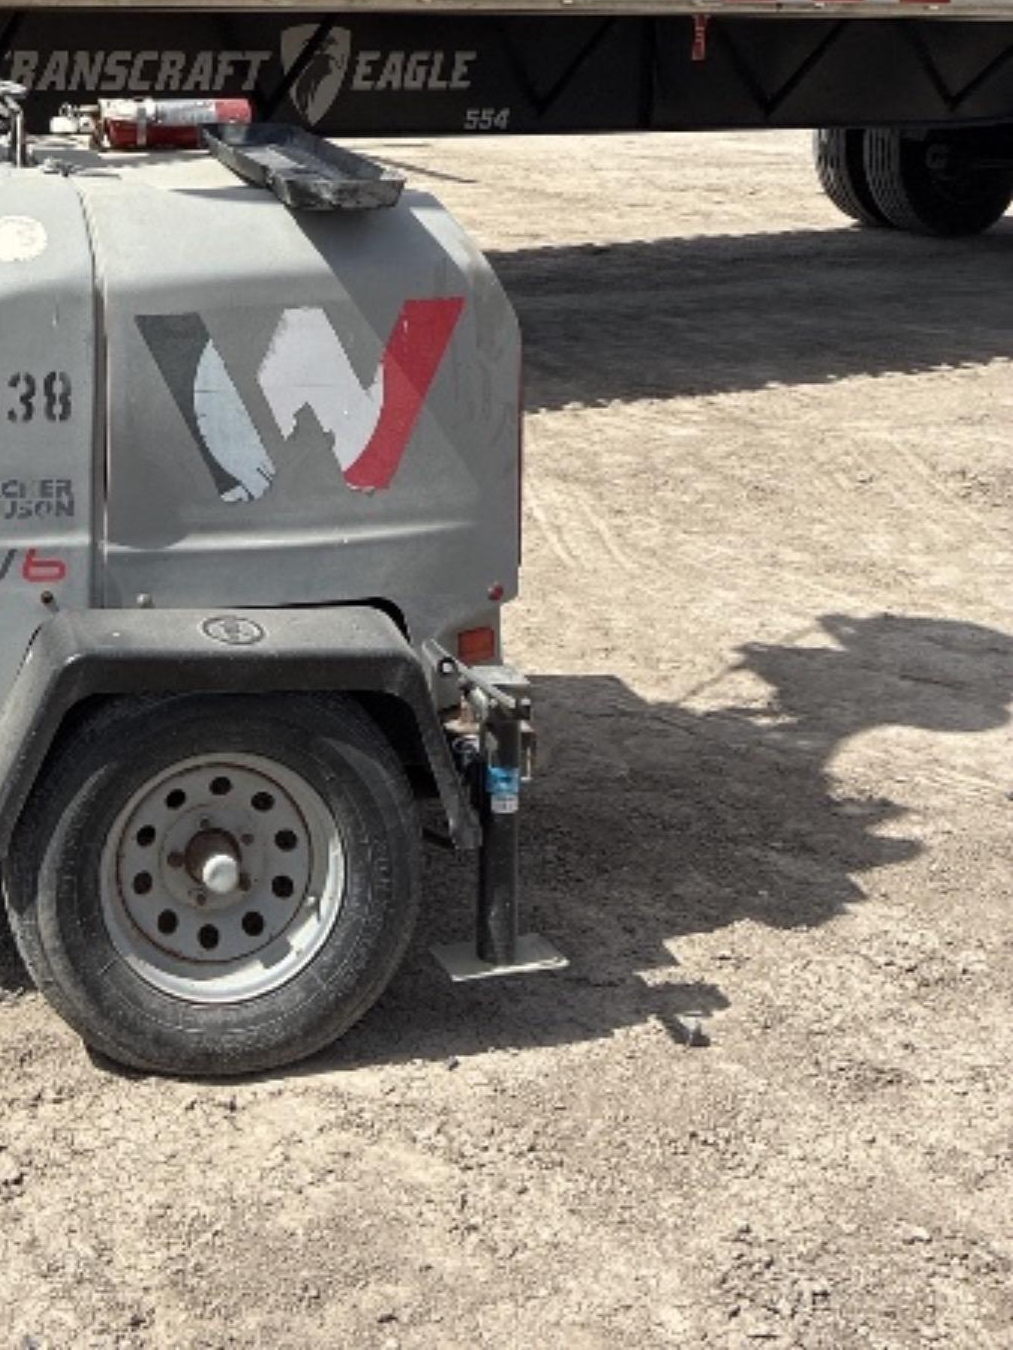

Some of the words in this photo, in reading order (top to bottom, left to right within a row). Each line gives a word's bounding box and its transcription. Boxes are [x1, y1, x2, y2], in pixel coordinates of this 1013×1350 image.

[6, 50, 272, 91] RANSCRAFT
[352, 50, 476, 91] EAGLE
[464, 108, 511, 130] 554
